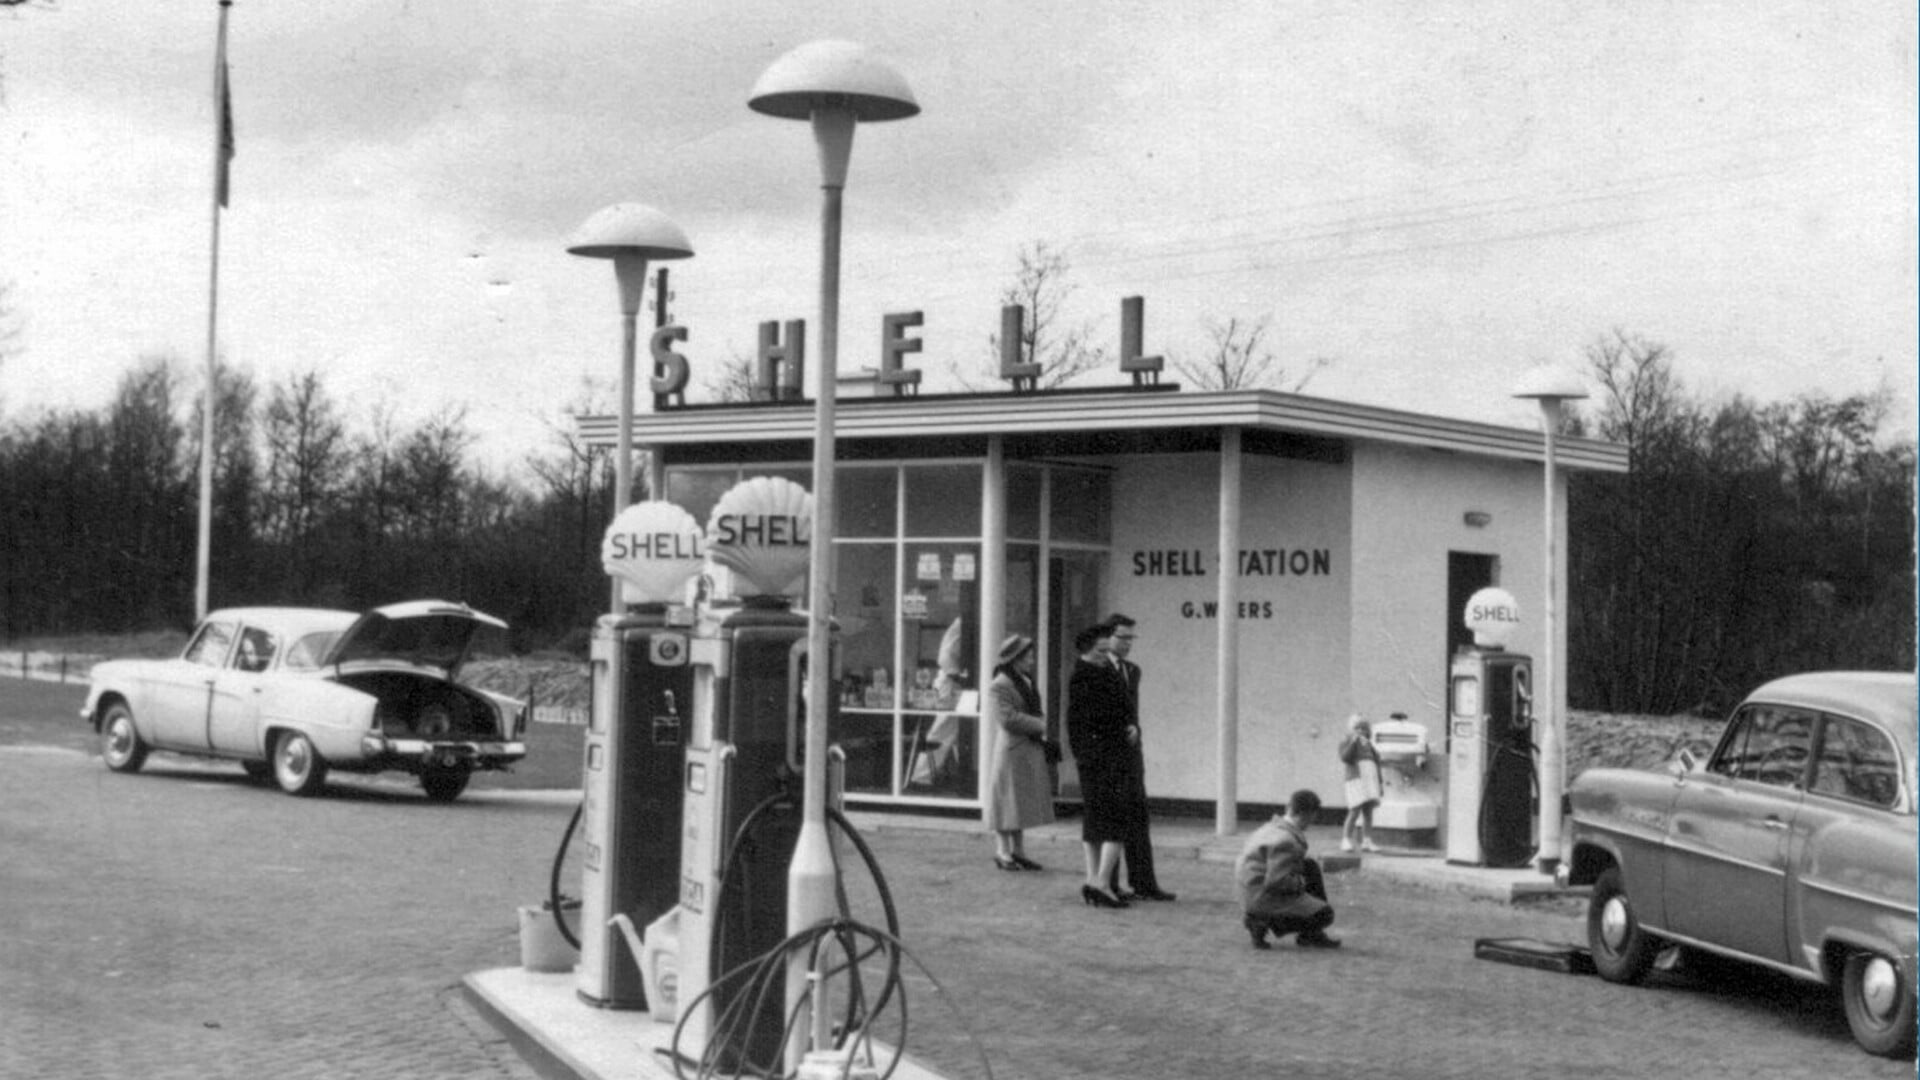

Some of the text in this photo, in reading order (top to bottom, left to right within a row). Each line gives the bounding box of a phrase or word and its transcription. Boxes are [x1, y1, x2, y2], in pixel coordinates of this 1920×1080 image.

[650, 296, 1164, 394] SHELL
[717, 514, 810, 546] SHEL
[611, 533, 704, 560] SHELL
[1132, 549, 1331, 577] SHELL TATION
[1181, 601, 1273, 619] G.WERS
[1473, 606, 1520, 623] SHELL
